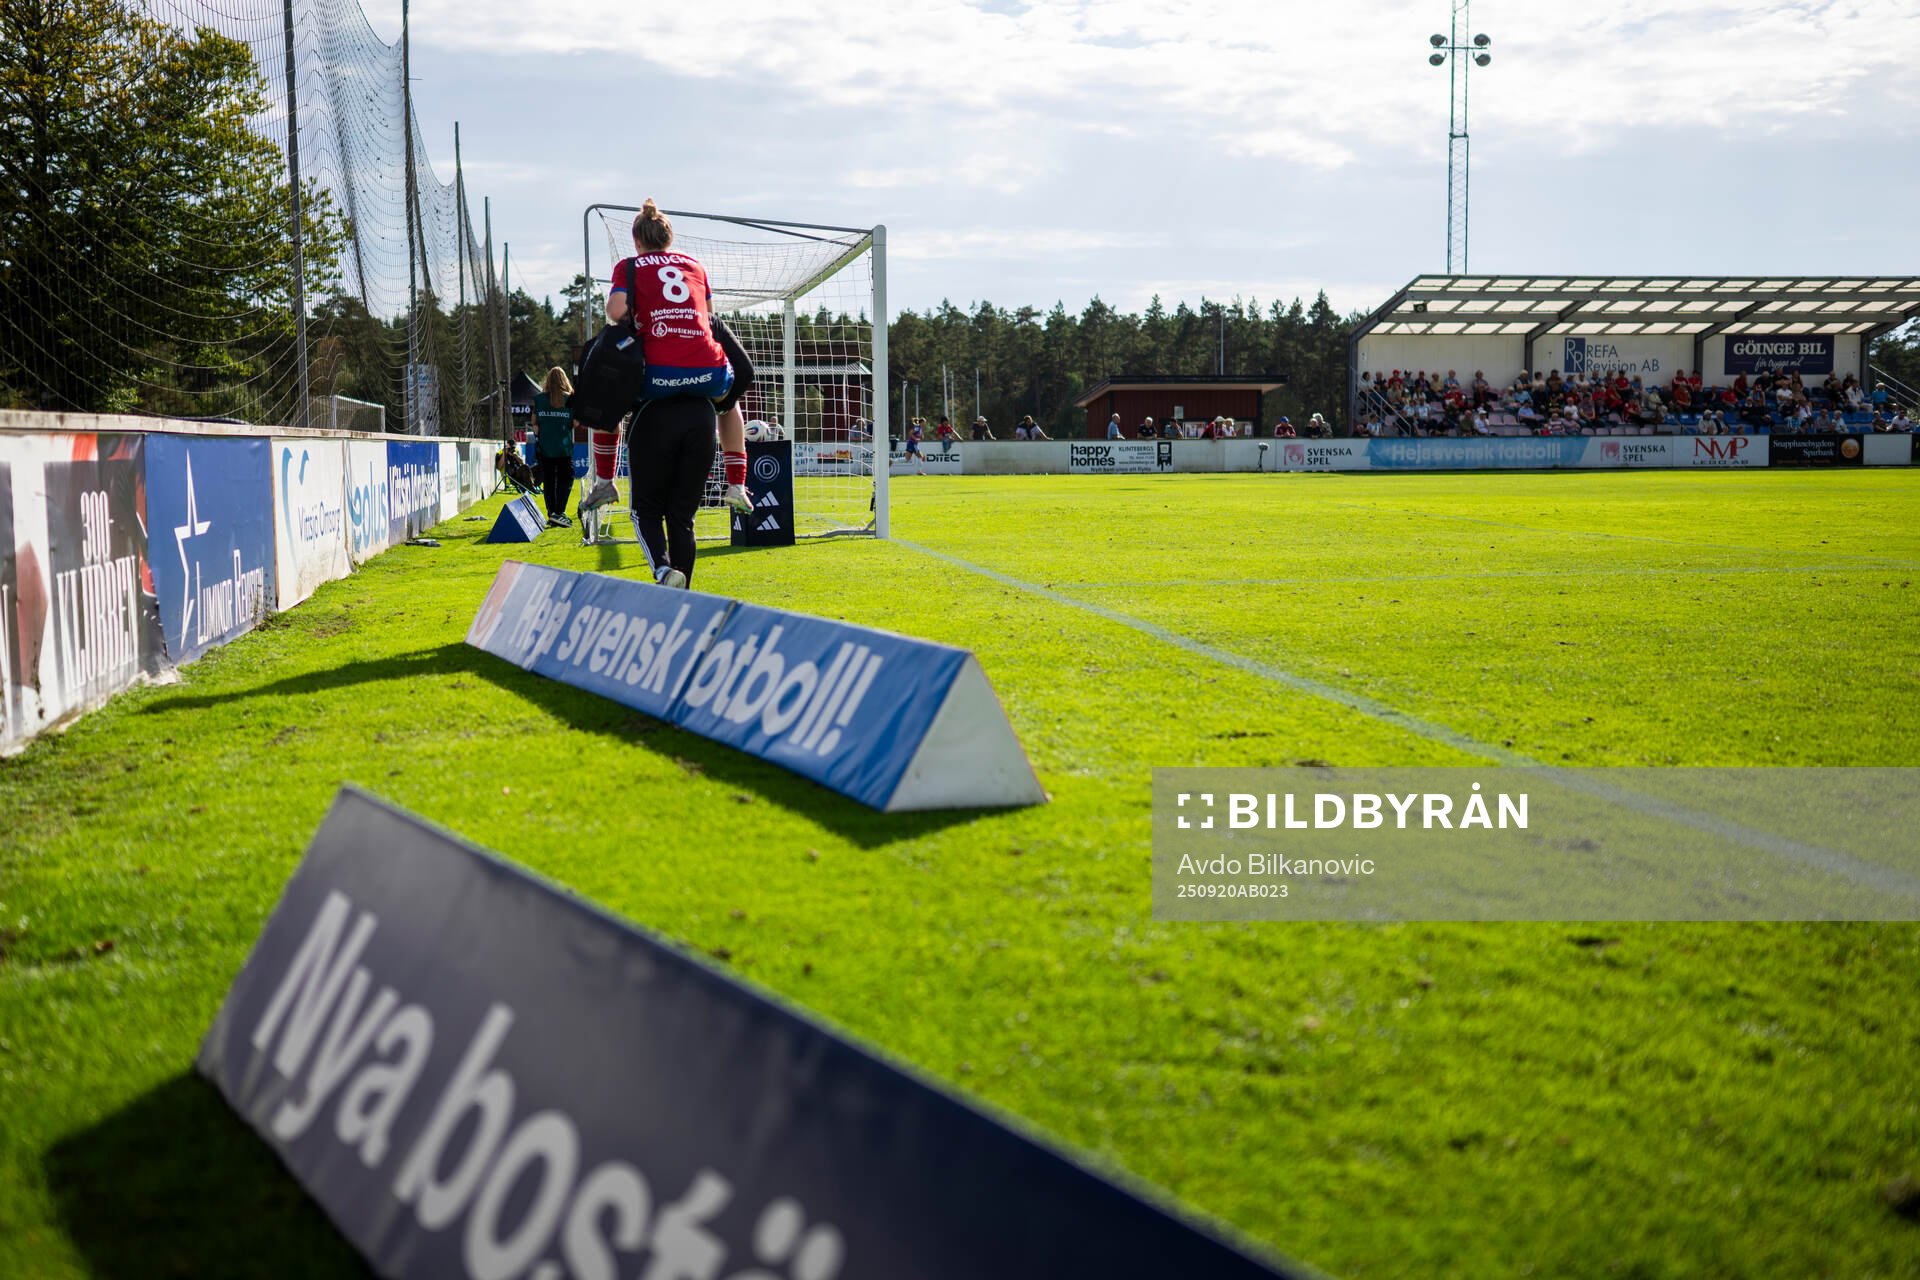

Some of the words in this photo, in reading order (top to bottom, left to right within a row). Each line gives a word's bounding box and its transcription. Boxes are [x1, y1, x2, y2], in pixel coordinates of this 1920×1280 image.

[657, 265, 690, 303] 8
[1586, 344, 1618, 358] REFA
[1733, 340, 1795, 355] GÖINGE
[1798, 342, 1826, 355] BIL
[1586, 359, 1637, 372] Revision
[1642, 359, 1660, 372] AB
[652, 372, 713, 387] KONECRANES
[1070, 443, 1111, 457] happy
[1307, 447, 1352, 456] SVENSKA
[1432, 444, 1494, 460] svensk
[1623, 444, 1666, 453] SVENSKA
[1693, 437, 1749, 459] NMP
[1802, 448, 1835, 459] Sparbank
[1070, 456, 1116, 466] homes
[1307, 457, 1331, 466] SPEL
[1623, 454, 1645, 462] SPEL
[56, 555, 140, 692] KLUBBEN
[556, 602, 693, 695] svensk
[664, 610, 884, 757] fotboll!
[252, 891, 433, 1168] Nya
